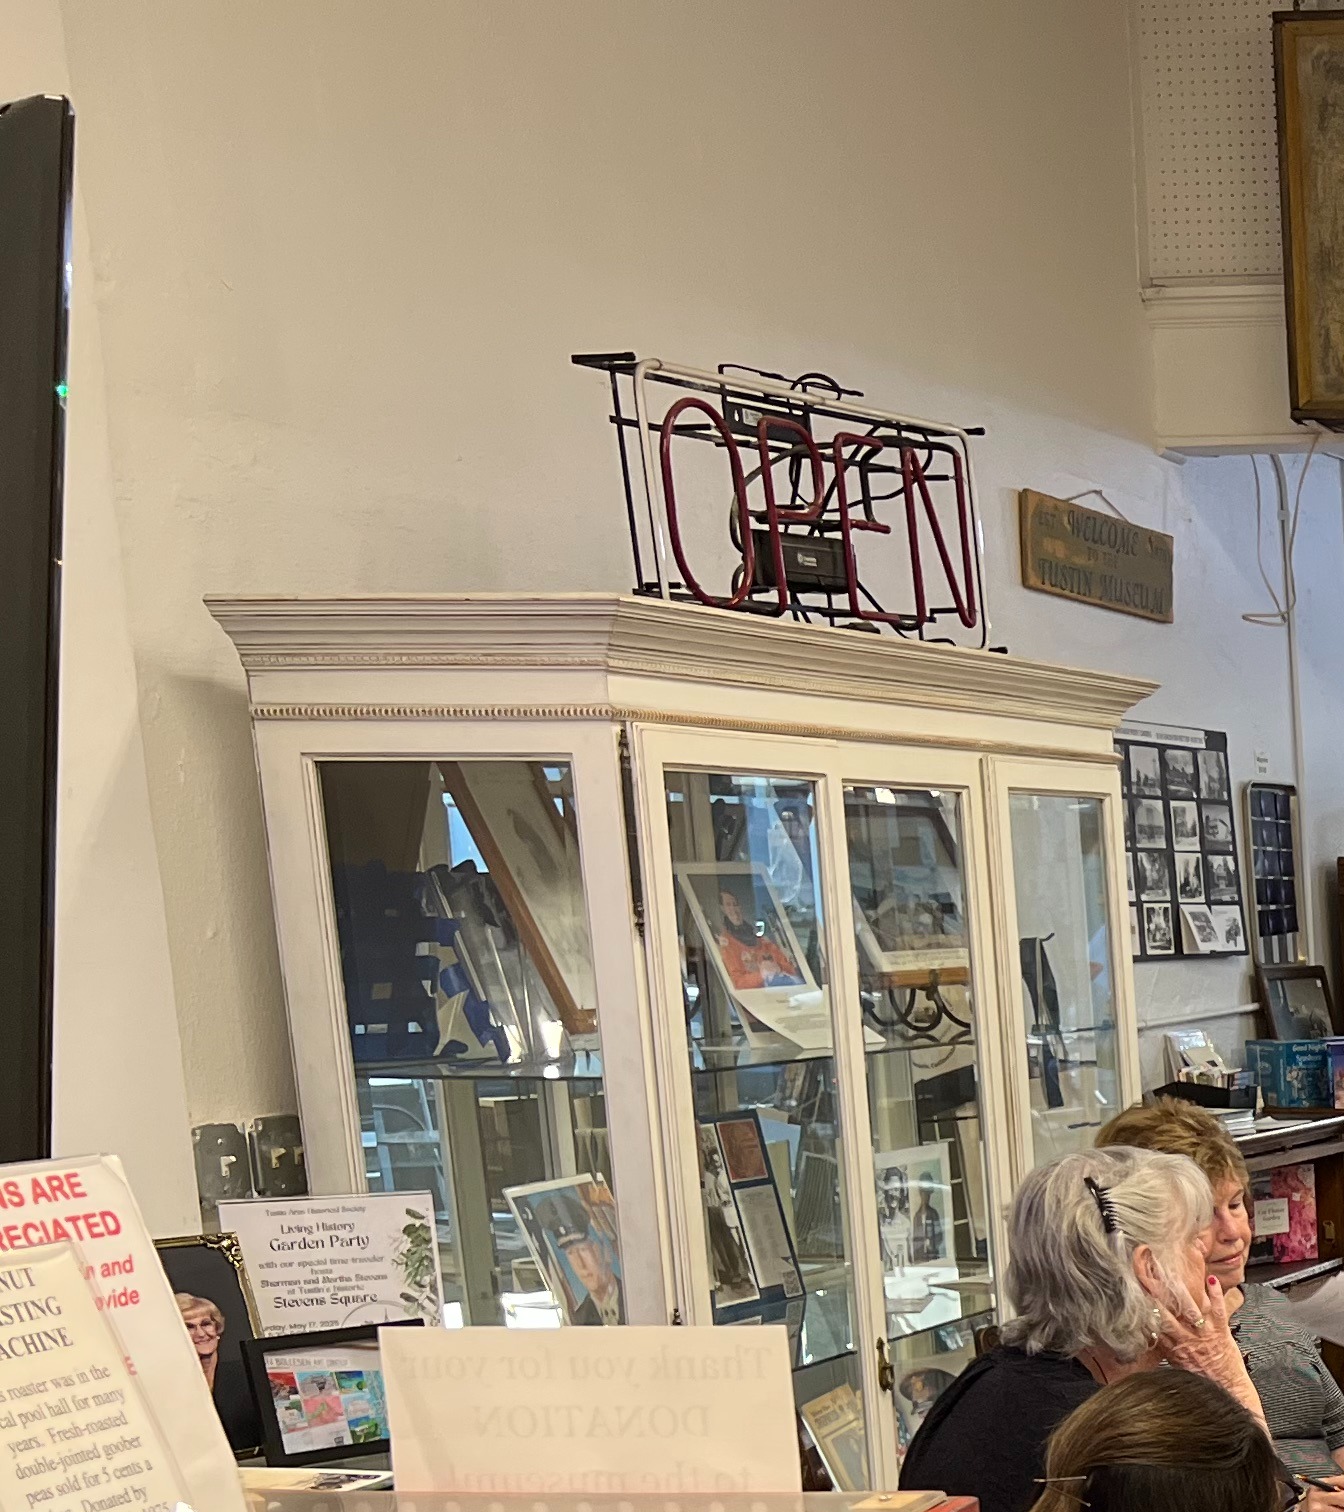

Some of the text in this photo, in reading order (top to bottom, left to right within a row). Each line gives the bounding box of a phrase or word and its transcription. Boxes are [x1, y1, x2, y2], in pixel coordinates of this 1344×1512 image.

[660, 397, 976, 630] OPEN
[1067, 510, 1140, 557] WELCOME
[1038, 558, 1092, 597] TUSTIN
[31, 1172, 88, 1205] ARE
[269, 1235, 370, 1252] Garden Party
[280, 1221, 356, 1236] Living History
[100, 1254, 135, 1278] and
[300, 1276, 320, 1285] and
[273, 1293, 378, 1309] Stevens Square
[7, 1379, 49, 1400] roaster
[50, 1375, 75, 1389] was
[77, 1370, 90, 1385] in
[90, 1364, 111, 1380] the
[18, 1404, 47, 1429] pool
[44, 1398, 72, 1418] hall
[72, 1394, 90, 1411] for
[92, 1388, 126, 1405] many
[8, 1410, 129, 1459] years. Fresh-roasted
[102, 1435, 142, 1460] goober
[26, 1459, 154, 1509] peas sold for 5 cents a
[132, 1484, 149, 1503] by
